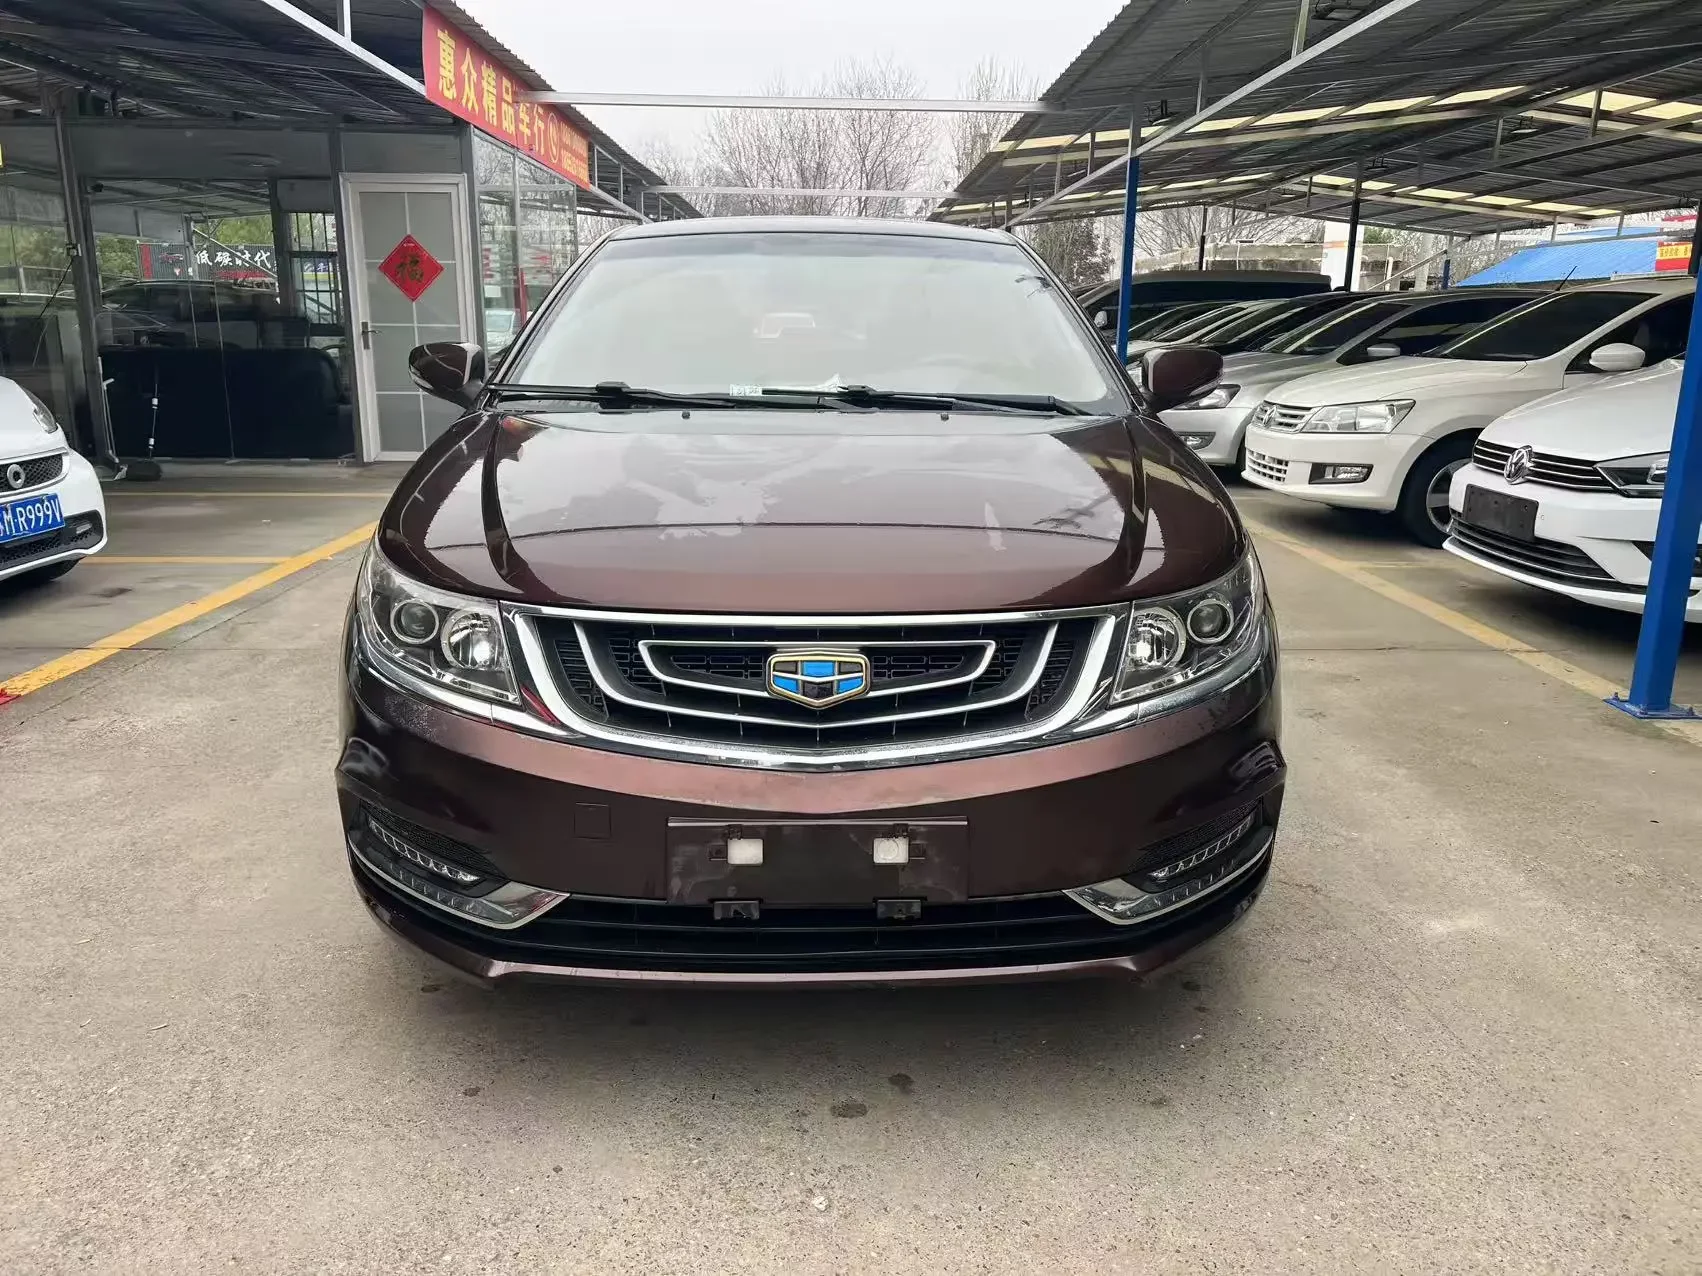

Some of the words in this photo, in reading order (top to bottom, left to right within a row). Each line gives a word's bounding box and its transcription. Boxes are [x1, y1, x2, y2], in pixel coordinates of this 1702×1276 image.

[437, 28, 546, 156] 惠众精品车行
